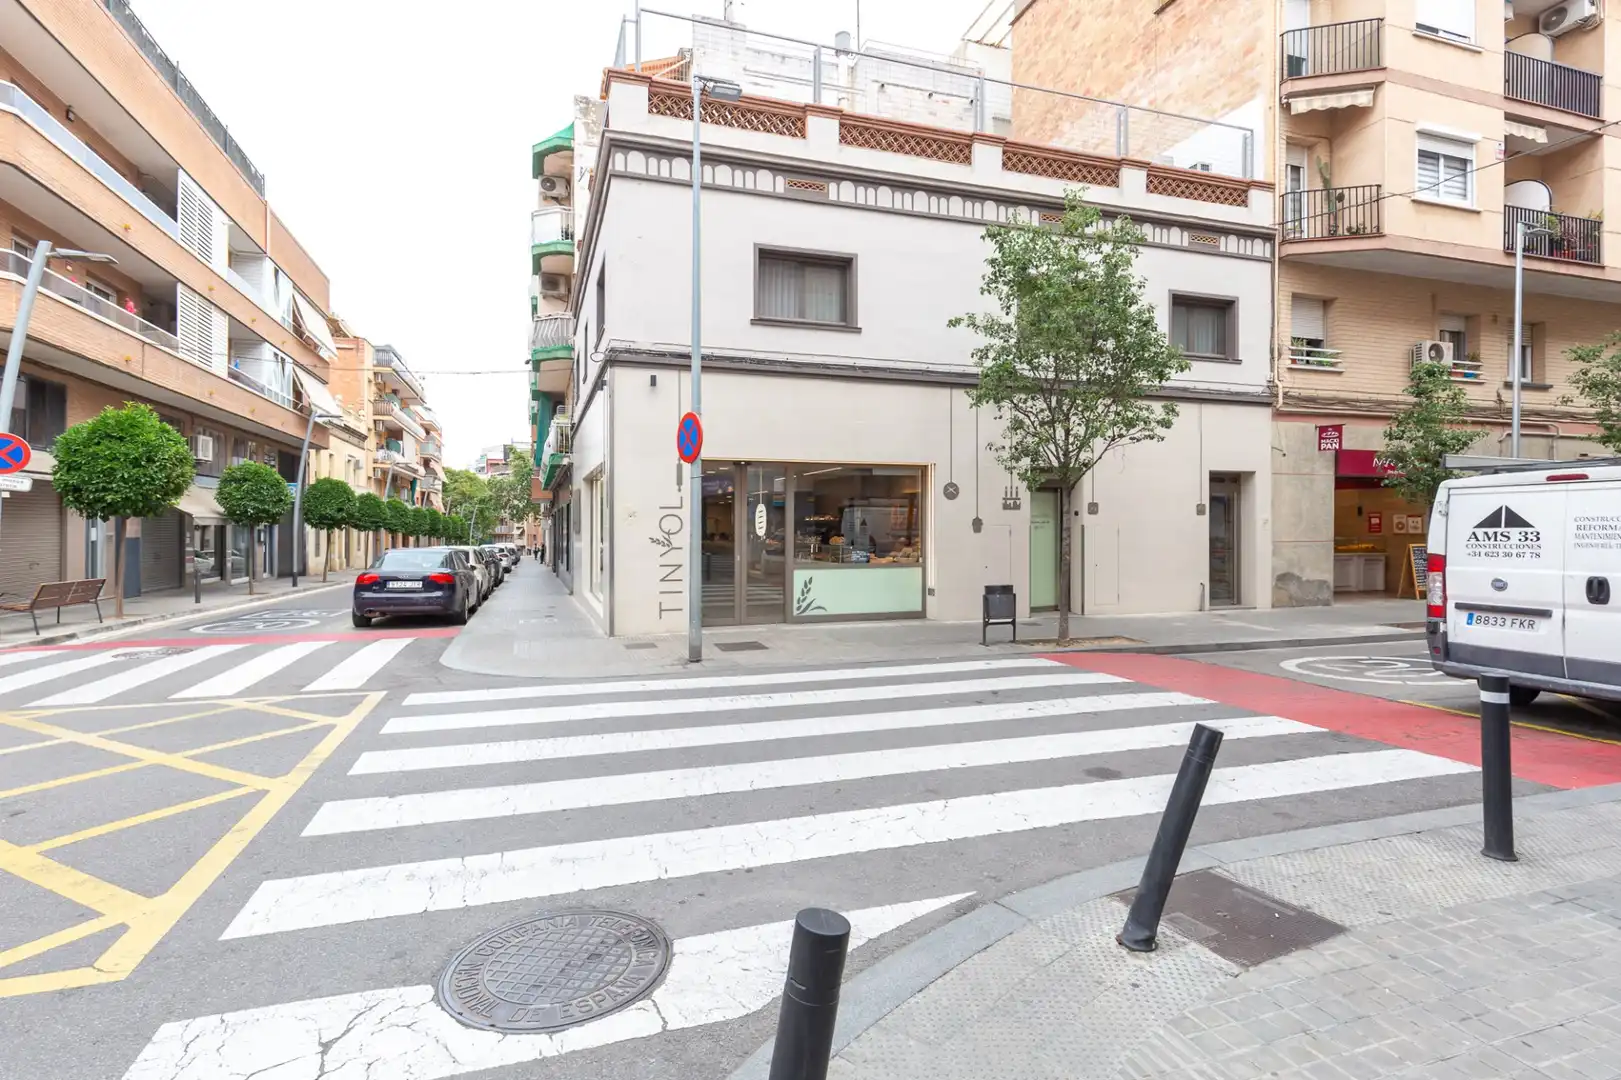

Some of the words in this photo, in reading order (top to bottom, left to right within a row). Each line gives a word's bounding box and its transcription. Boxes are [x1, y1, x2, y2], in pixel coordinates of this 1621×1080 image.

[1466, 531, 1511, 542] AMS
[1518, 530, 1541, 542] 33
[658, 495, 684, 620] TINYOL
[1475, 614, 1507, 627] 8833
[1510, 618, 1536, 630] FKR
[454, 962, 501, 1019] NACIONAL
[507, 1007, 544, 1023] DE
